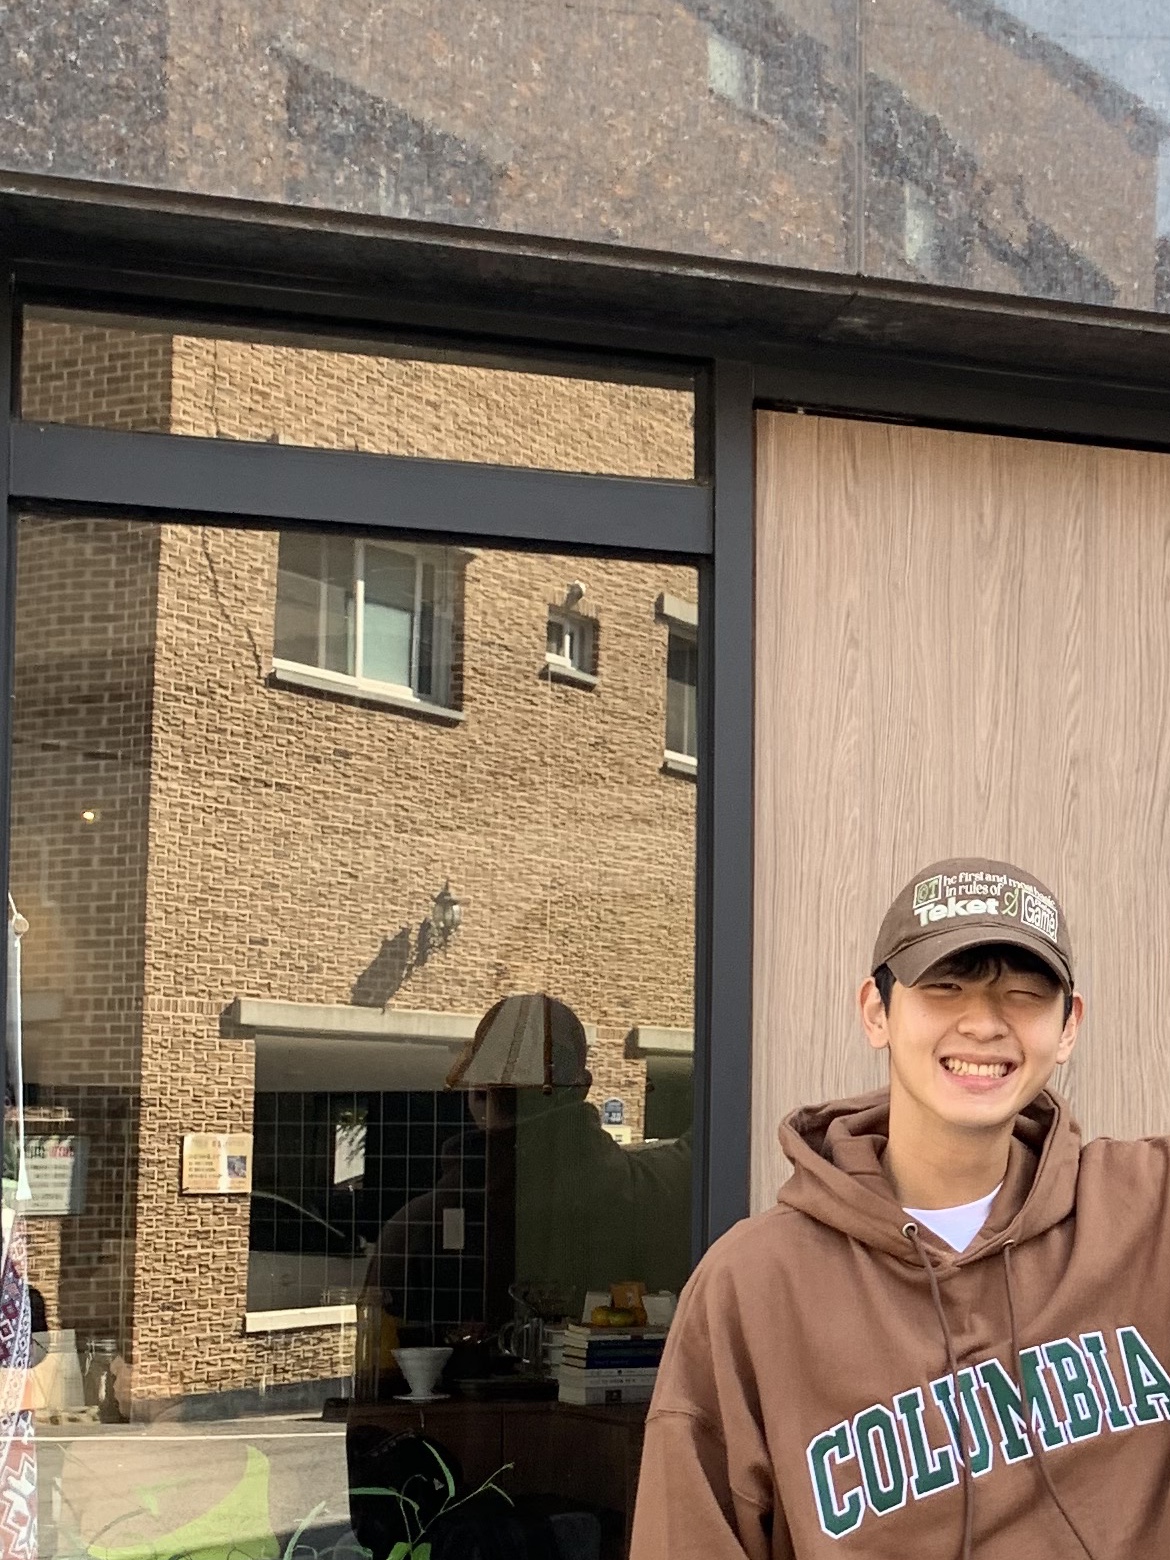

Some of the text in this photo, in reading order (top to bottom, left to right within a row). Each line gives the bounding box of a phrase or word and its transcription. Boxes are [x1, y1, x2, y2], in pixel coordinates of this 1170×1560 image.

[958, 871, 984, 883] first
[985, 873, 1007, 885] and
[945, 880, 1005, 898] in rules of
[914, 896, 1000, 928] Teket
[1025, 895, 1056, 938] Game
